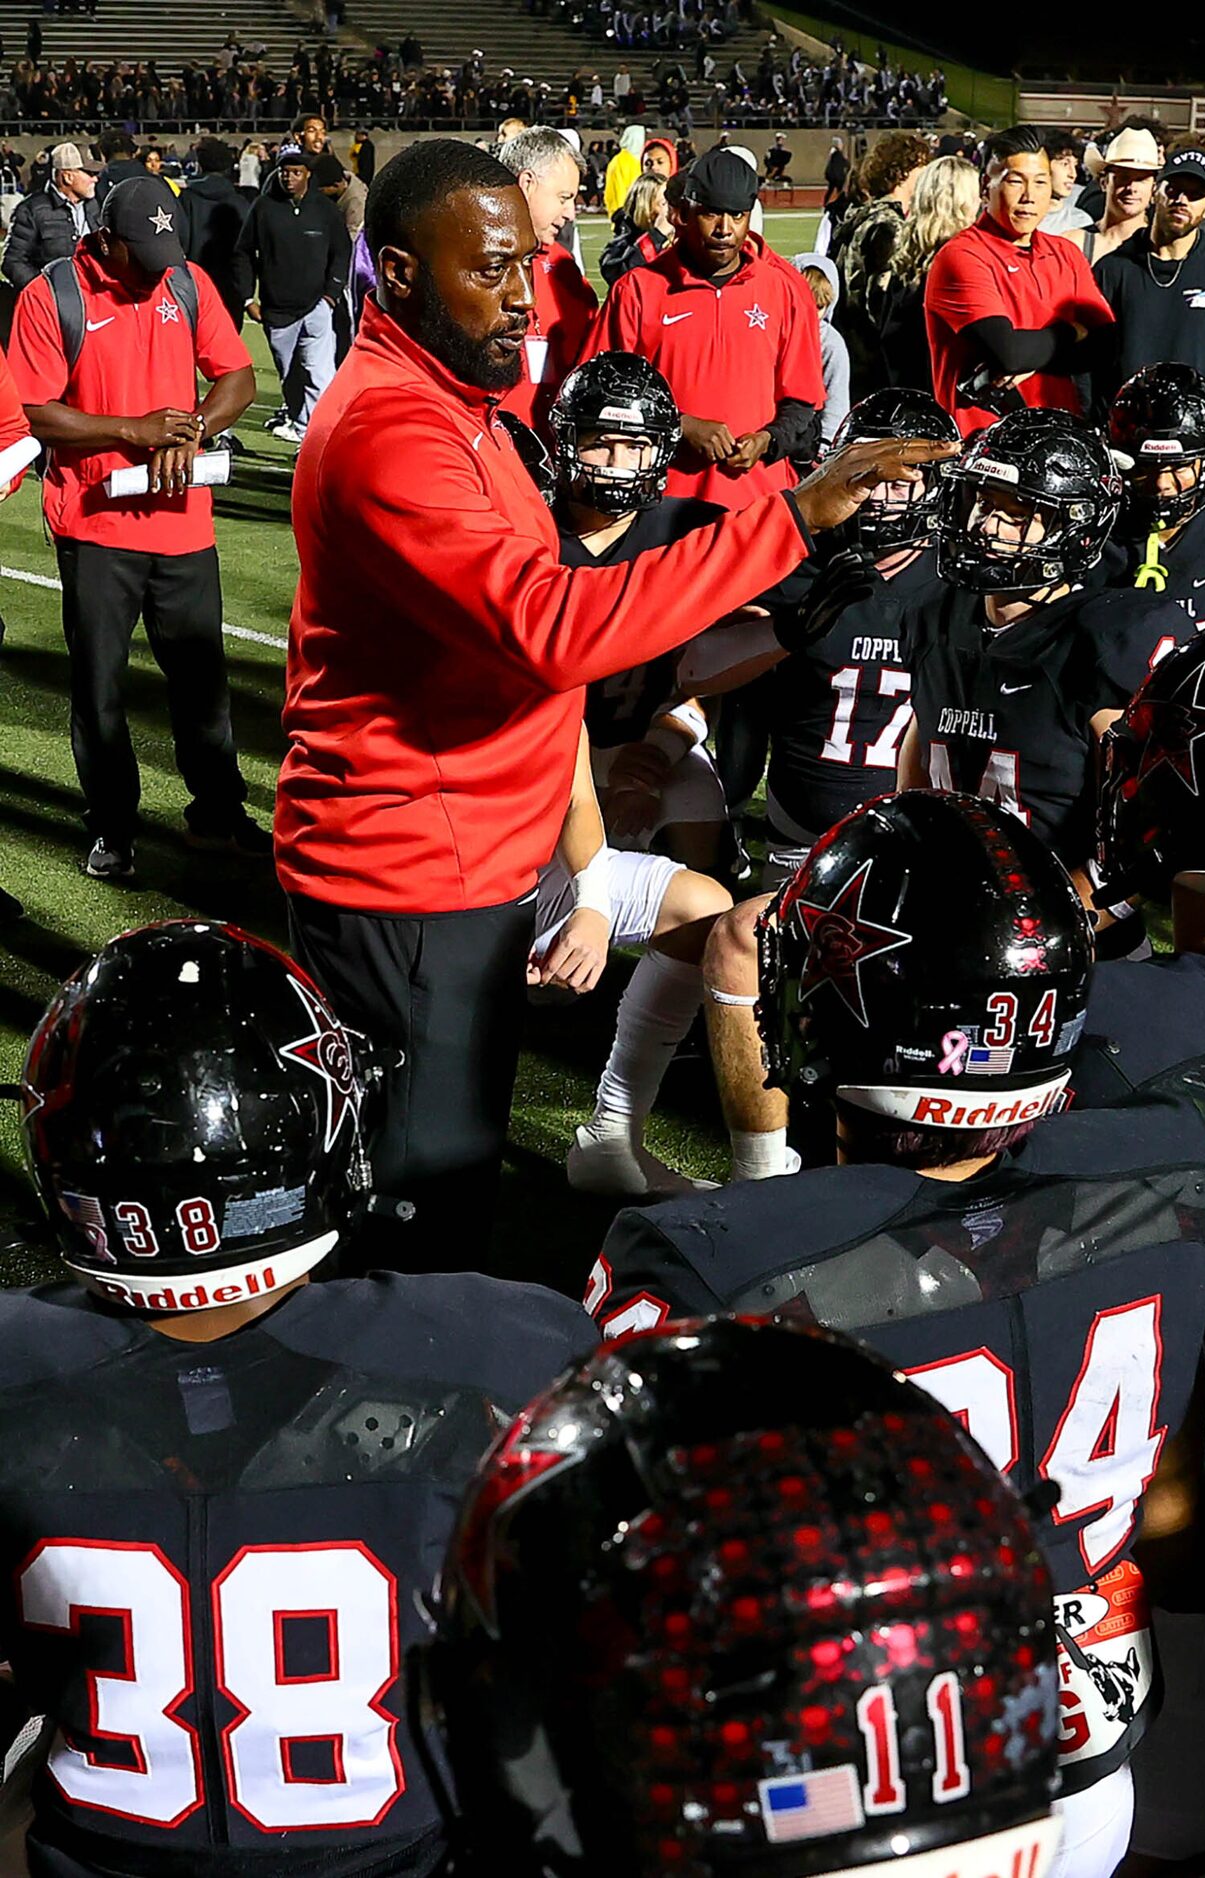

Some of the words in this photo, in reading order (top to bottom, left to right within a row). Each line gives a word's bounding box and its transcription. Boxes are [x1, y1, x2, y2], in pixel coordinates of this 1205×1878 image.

[818, 665, 915, 770] 17
[937, 706, 998, 744] COPPELL
[983, 988, 1058, 1049] 34
[911, 1086, 1059, 1126] Riddell
[115, 1196, 221, 1258] 38
[15, 1536, 407, 1834] 38
[856, 1670, 970, 1817] 11
